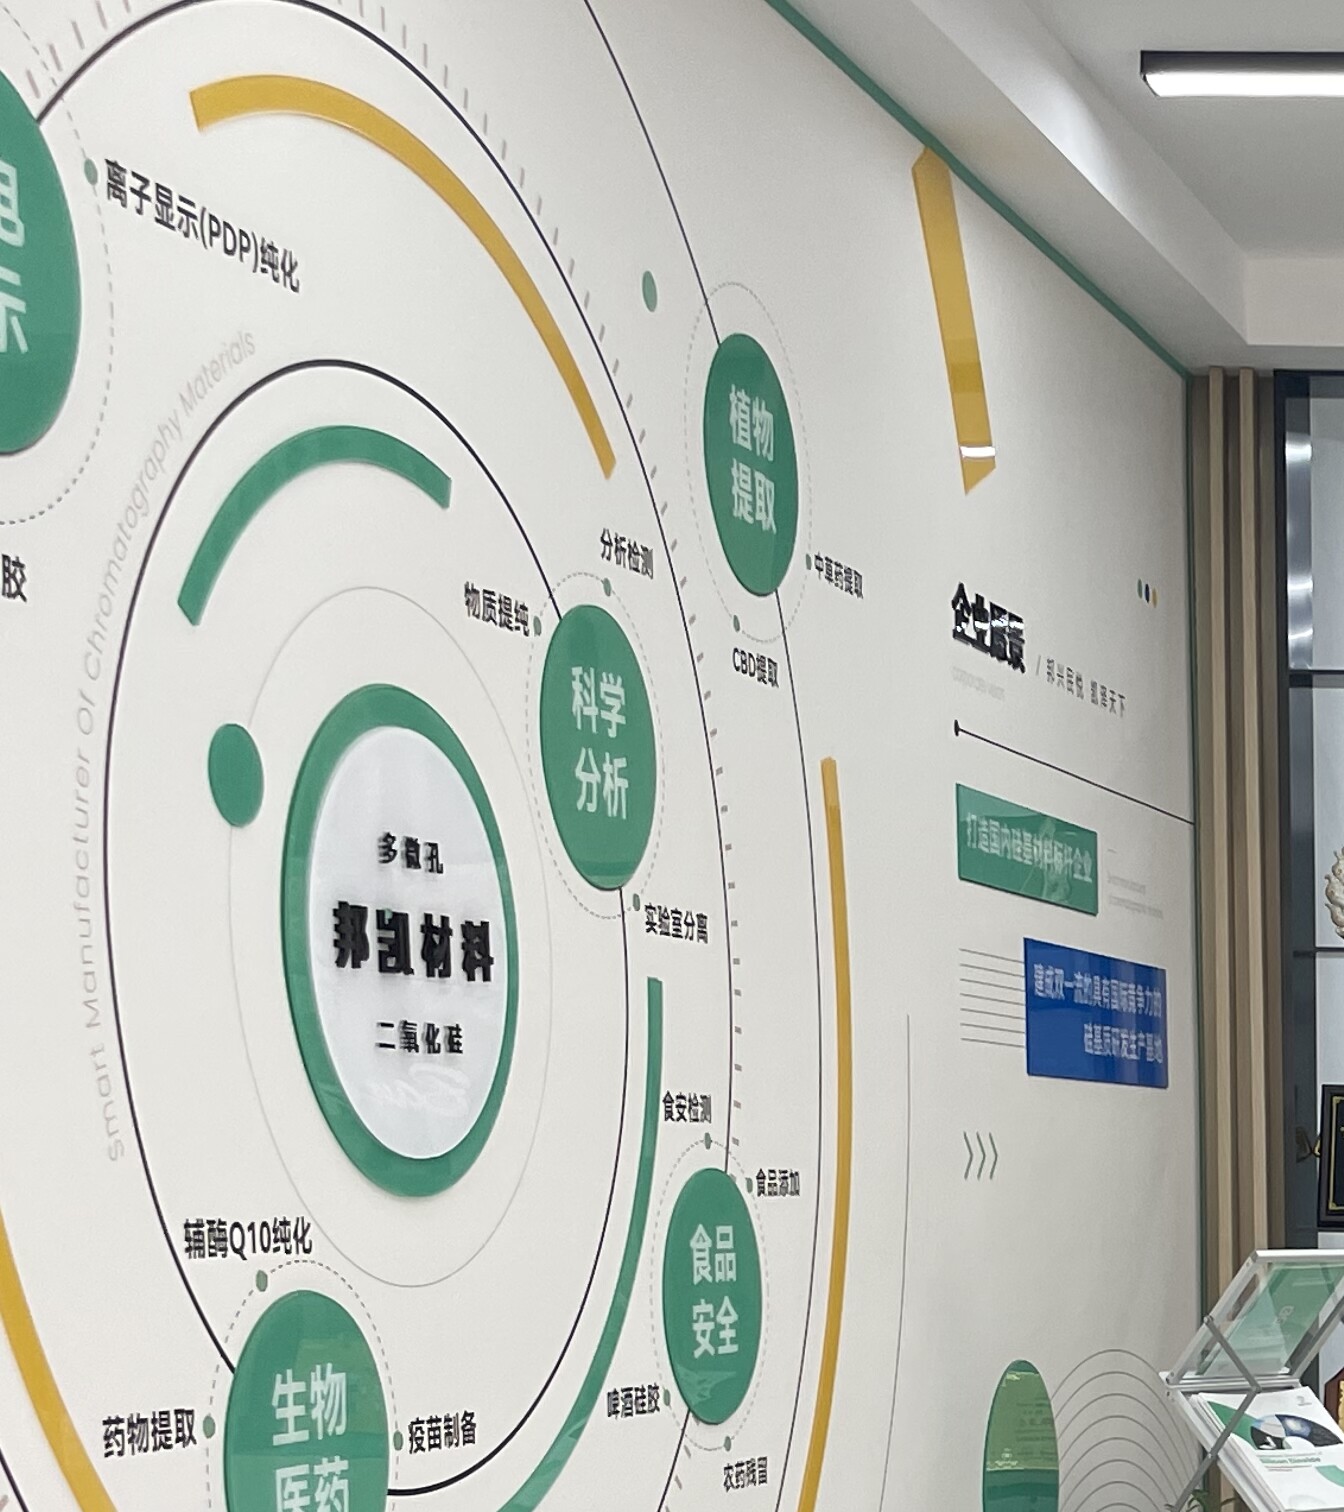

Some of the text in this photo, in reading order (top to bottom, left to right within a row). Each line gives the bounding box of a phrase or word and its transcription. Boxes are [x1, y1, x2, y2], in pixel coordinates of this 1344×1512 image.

[104, 159, 300, 293] 离子显示(PDP)纯化
[178, 330, 257, 417] Materials
[729, 384, 775, 462] 植物
[730, 461, 777, 535] 提取
[84, 408, 182, 682] Chromatography
[600, 527, 654, 580] 分析检测
[463, 581, 530, 638] 物质提纯
[732, 646, 780, 689] CBD提取
[571, 665, 627, 738] 科学
[574, 746, 629, 820] 分析
[377, 831, 444, 875] 多微孔
[72, 747, 99, 1029] Manufacturer
[332, 900, 495, 983] 邦凯材料
[644, 902, 708, 944] 实验室分离
[375, 1019, 464, 1055] 二氧化硅
[662, 1089, 712, 1124] 食安检测
[755, 1168, 801, 1198] 食品添加
[183, 1215, 314, 1260] 辅酶Q10纯化
[690, 1223, 737, 1285] 食品
[692, 1295, 739, 1359] 安全
[271, 1362, 348, 1446] 生物
[607, 1382, 660, 1420] 啤酒硅胶
[101, 1407, 198, 1459] 药物提取
[408, 1409, 477, 1454] 疫苗制备
[723, 1455, 768, 1493] 农药残留
